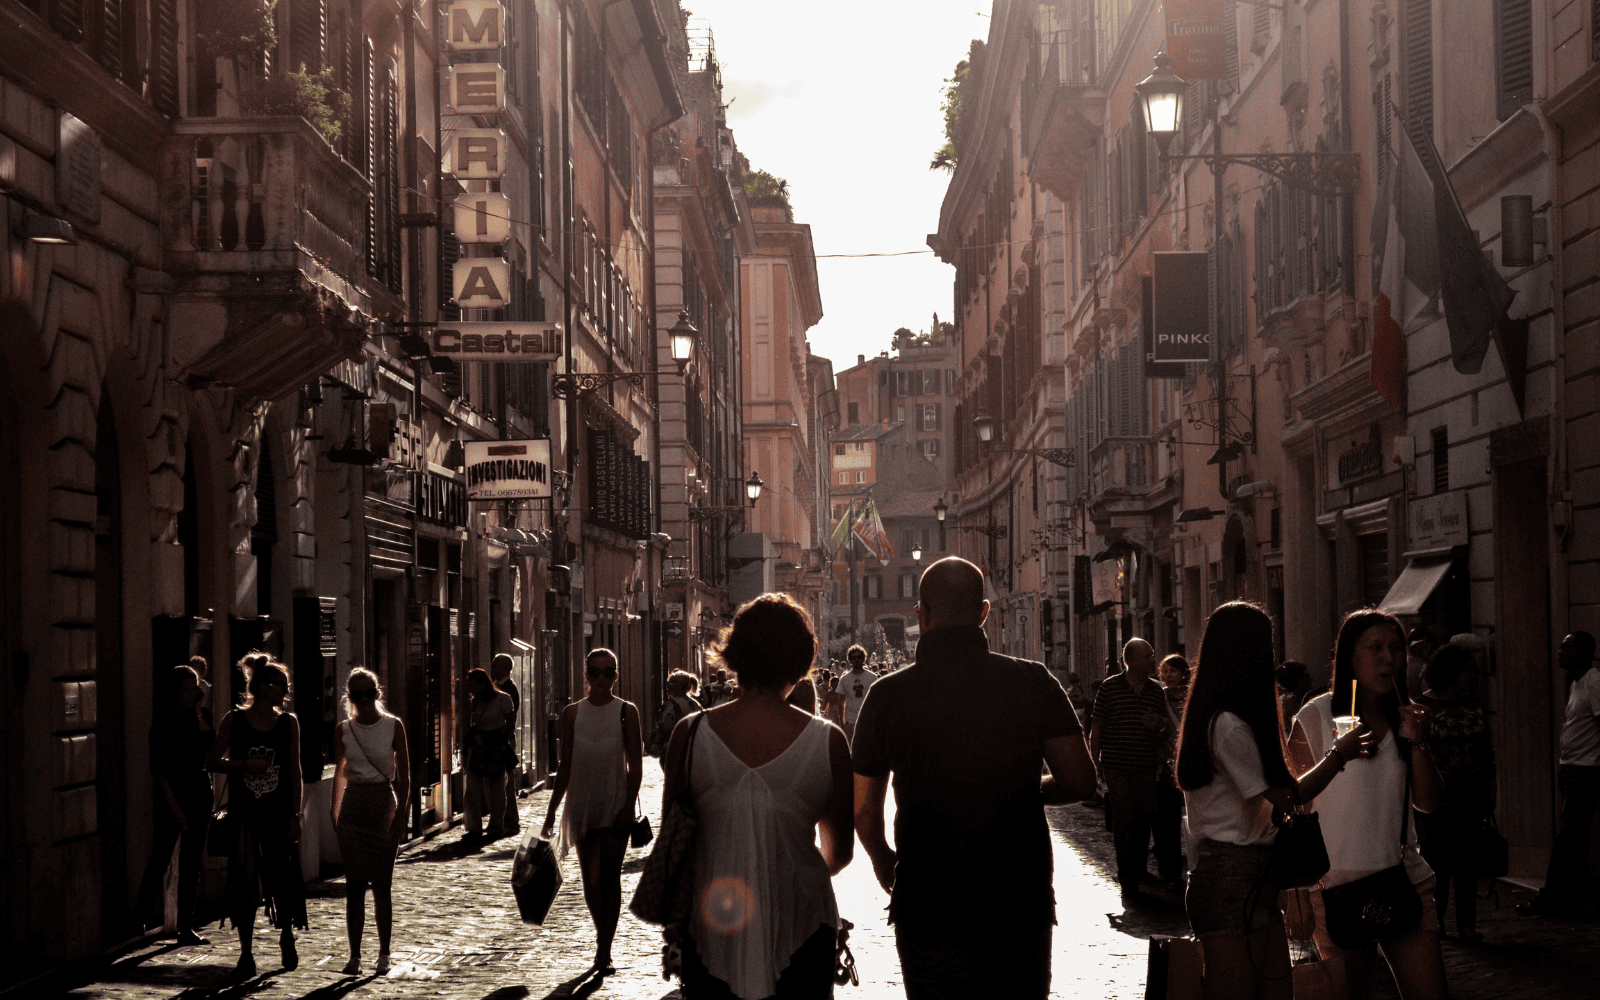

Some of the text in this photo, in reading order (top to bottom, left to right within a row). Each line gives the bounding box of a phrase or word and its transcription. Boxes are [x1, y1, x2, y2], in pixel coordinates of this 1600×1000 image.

[467, 458, 547, 488] INVESTIGAZIONI
[596, 435, 606, 519] FLAVIO CASTELLANI
